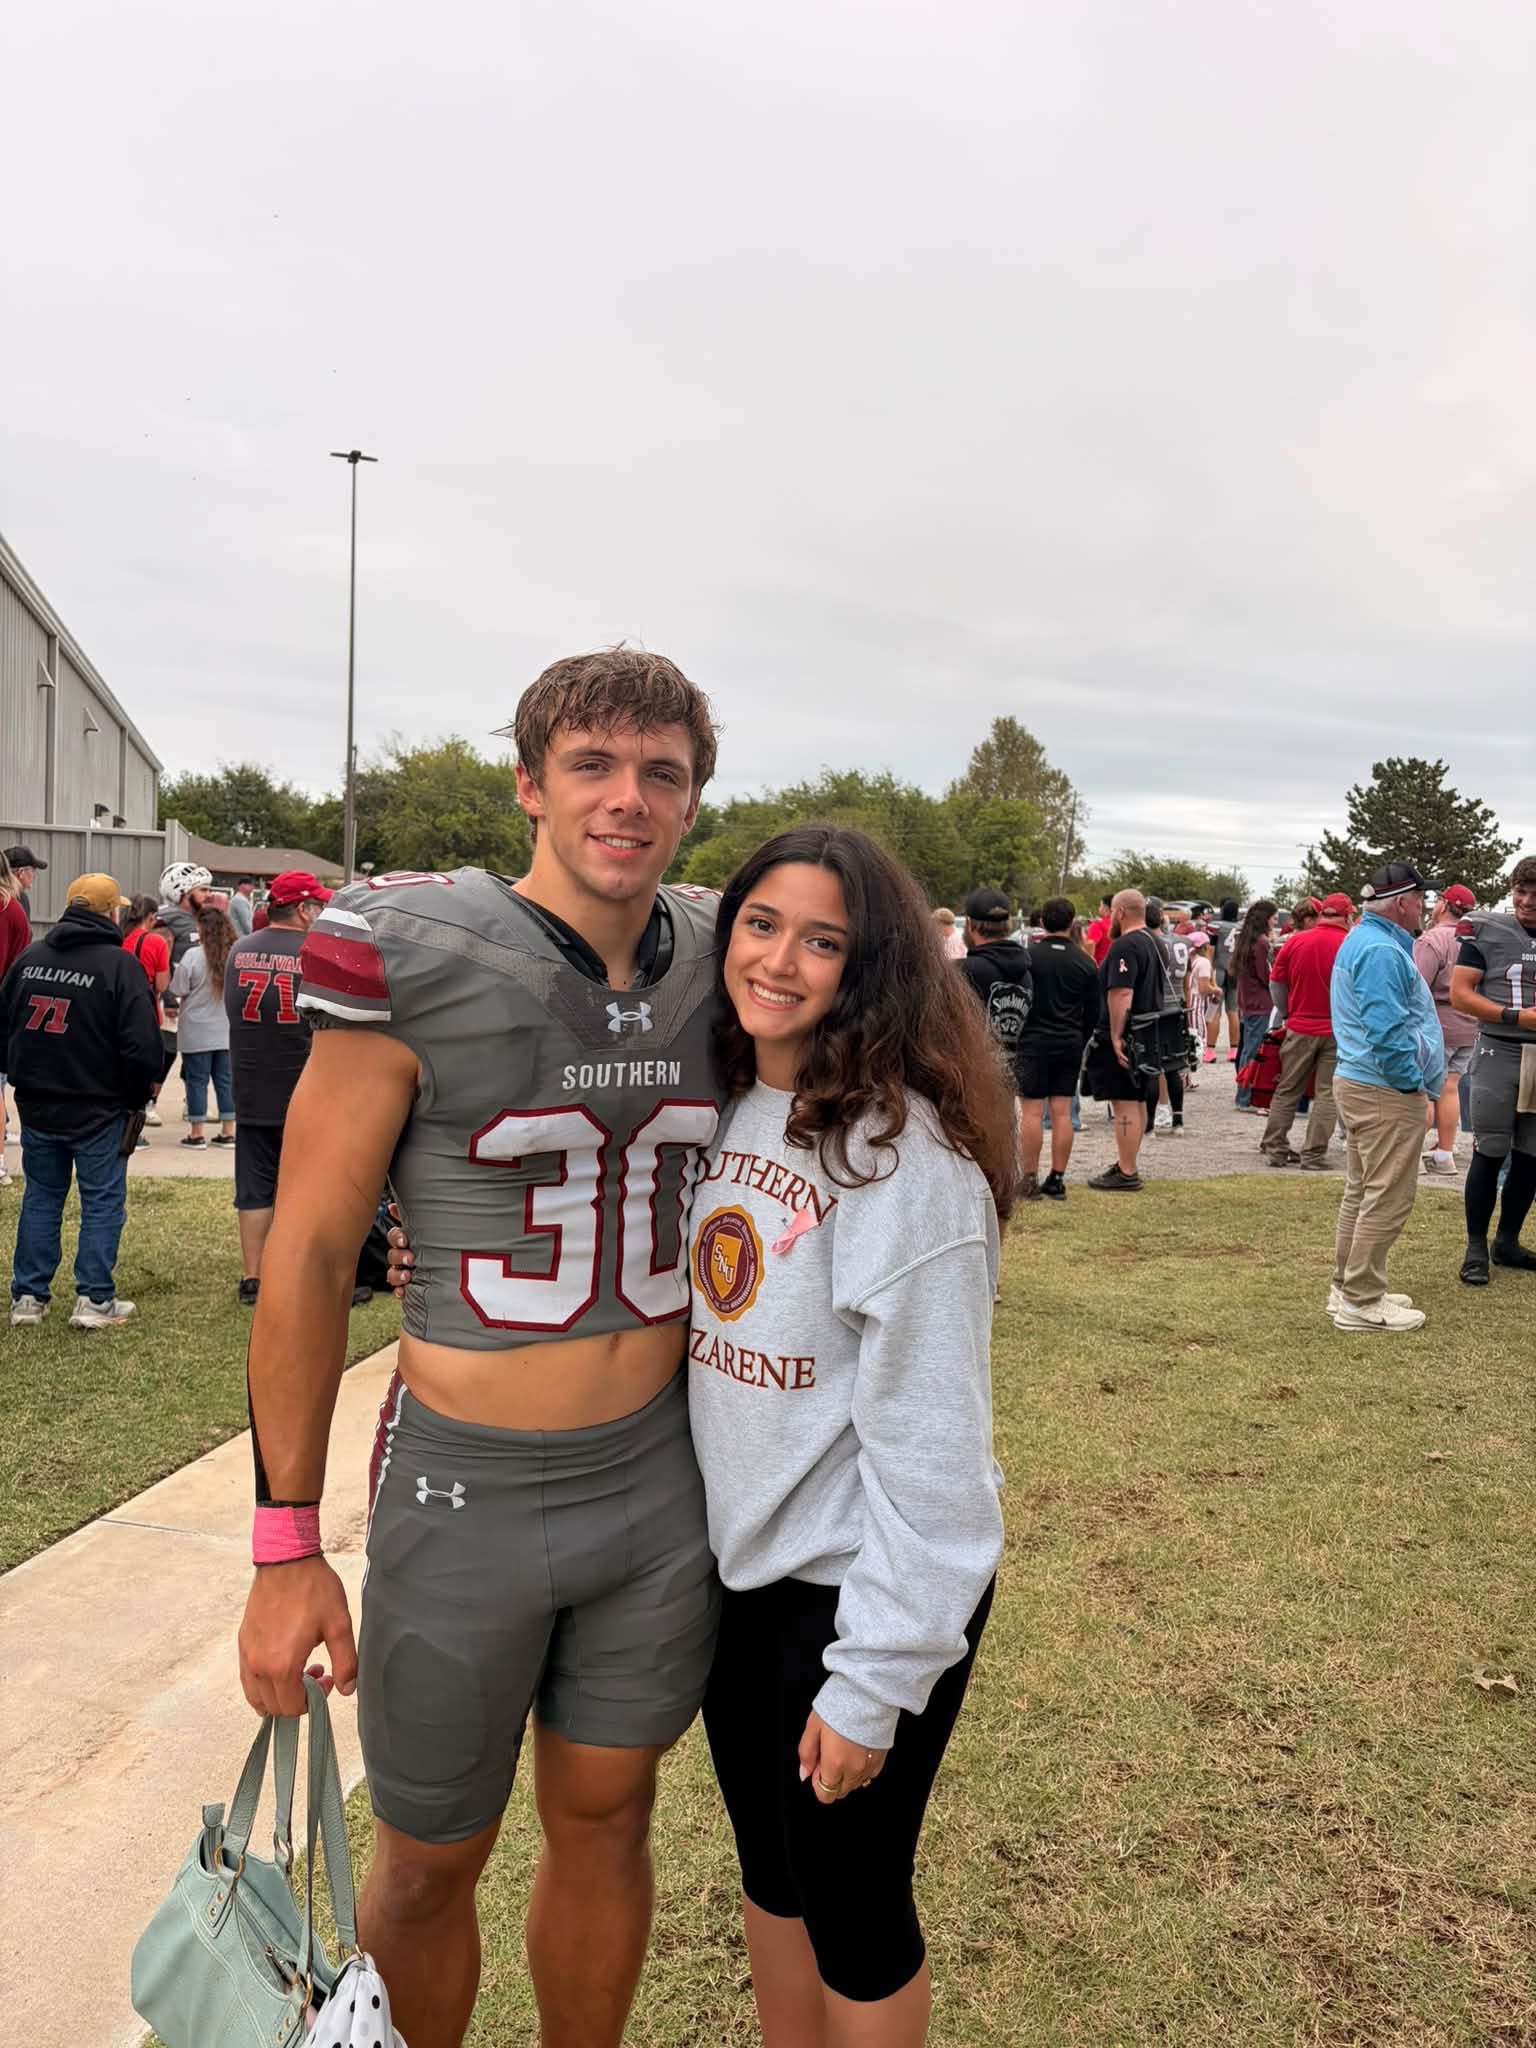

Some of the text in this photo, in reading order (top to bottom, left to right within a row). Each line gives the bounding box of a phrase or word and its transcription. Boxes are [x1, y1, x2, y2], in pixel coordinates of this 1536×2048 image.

[1223, 927, 1241, 953] 4
[21, 966, 95, 989] SULLIVAN
[1166, 942, 1189, 978] 9
[25, 994, 71, 1034] 71
[239, 969, 299, 1024] 71
[562, 1060, 681, 1090] SOUTHERN
[460, 1098, 720, 1332] 30
[714, 1243, 735, 1284] SNU
